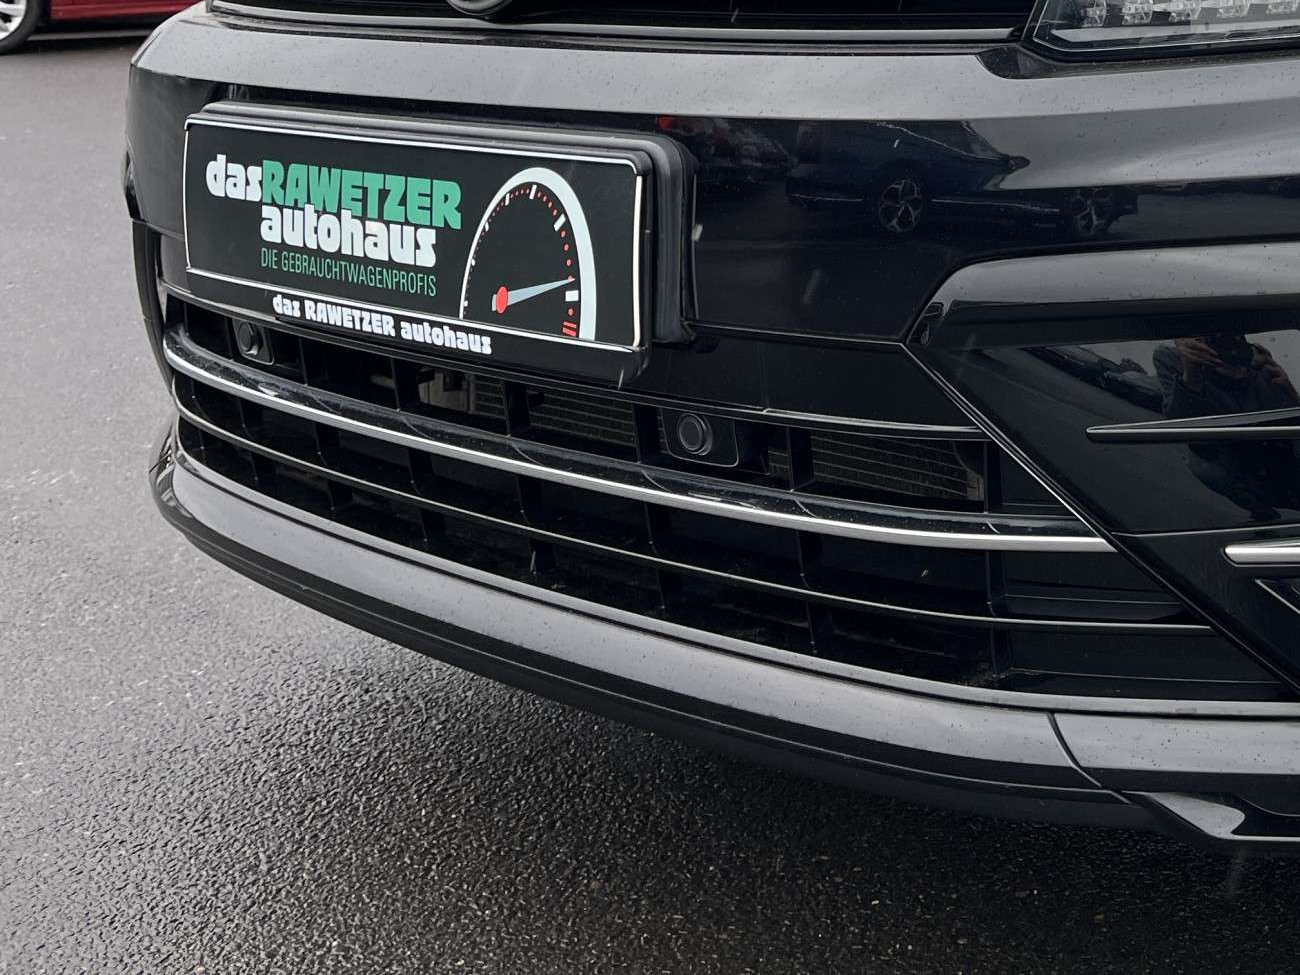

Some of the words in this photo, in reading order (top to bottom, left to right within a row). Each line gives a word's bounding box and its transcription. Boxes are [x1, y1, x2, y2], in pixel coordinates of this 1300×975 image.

[260, 204, 437, 267] autohaus
[261, 247, 278, 268] DIE
[281, 251, 437, 297] GEBRAUCHTWAGENPROFIS
[272, 294, 301, 317] das
[305, 299, 396, 337] RAWETZER
[400, 321, 493, 355] autohaus
